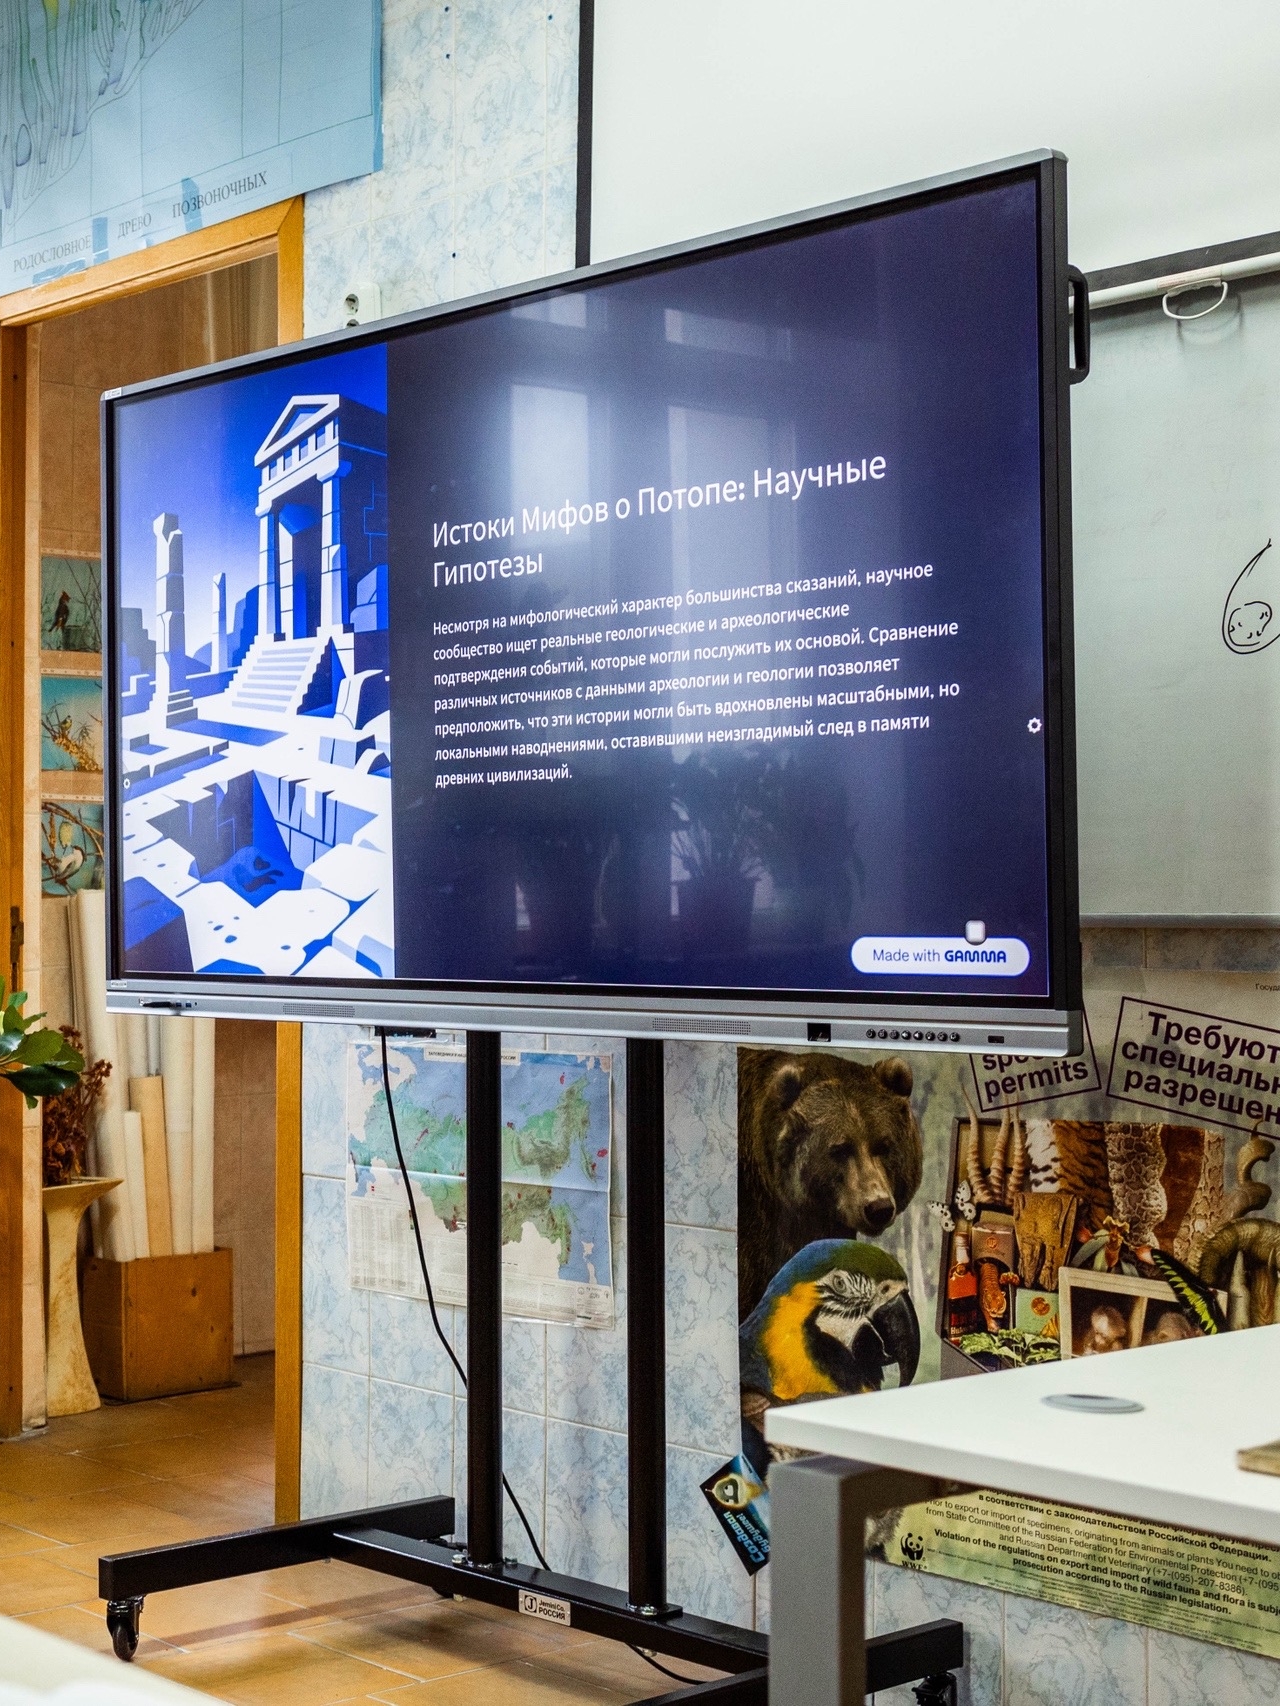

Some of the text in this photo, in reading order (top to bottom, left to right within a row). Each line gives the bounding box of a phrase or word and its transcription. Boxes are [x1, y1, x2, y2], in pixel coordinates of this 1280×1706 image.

[13, 170, 268, 272] РОДОСЛОВНОЕ ДРЕВО ПОЗВОНОЧНЫХ
[433, 455, 886, 548] Истоки Мифов о Потопе: Научные
[433, 553, 543, 588] Гипотезы
[433, 563, 933, 636] Несмотря на мифологический характер большинства сказаний, научное
[433, 602, 850, 661] сообщество ищет реальные геологические и археологические
[433, 621, 959, 687] подтверждения событий, которые могли послужить их основой. Сравнение
[434, 656, 900, 714] различных источников с данными археологии и геологии позволяет
[435, 683, 960, 737] предположить, что эти истории могли быть вдохновлены масштабными, но
[435, 715, 930, 761] локальными наводнениями, оставившими неизгладимый след в памяти
[436, 763, 572, 789] древних цивилизаций.
[873, 949, 1007, 963] Made with GAMMA
[984, 1060, 1089, 1103] permits
[1124, 1069, 1280, 1125] разрешен
[925, 1506, 945, 1518] from
[946, 1511, 967, 1522] State
[968, 1515, 1011, 1532] Committee
[1012, 1523, 1021, 1533] of
[1021, 1527, 1034, 1537] the
[1034, 1530, 1068, 1544] Russian
[1069, 1535, 1113, 1554] Federation
[1114, 1546, 1127, 1557] for
[1128, 1550, 1189, 1572] Environmental
[1190, 1564, 1237, 1582] Protection
[945, 1500, 954, 1509] to
[954, 1503, 980, 1515] export
[981, 1508, 989, 1516] or
[990, 1509, 1016, 1523] import
[1017, 1516, 1026, 1524] of
[1026, 1518, 1073, 1536] specimens,
[1074, 1528, 1118, 1546] originating
[1119, 1537, 1140, 1549] from
[1141, 1544, 1175, 1557] animals
[1176, 1551, 1185, 1559] or
[1187, 1553, 1214, 1566] plants
[1215, 1558, 1234, 1570] You
[1235, 1564, 1258, 1576] need
[1260, 1567, 1270, 1578] to
[985, 1495, 1045, 1515] соответствии
[1054, 1510, 1147, 1536] законодательством
[1148, 1528, 1207, 1549] Российской
[1209, 1541, 1272, 1562] Федерации.
[999, 1533, 1015, 1543] and
[1016, 1537, 1045, 1550] Russian
[1047, 1543, 1096, 1562] Department
[1098, 1554, 1107, 1564] of
[1108, 1557, 1151, 1575] Veterinary
[934, 1528, 971, 1543] Violation
[972, 1537, 982, 1546] of
[983, 1539, 997, 1549] the
[998, 1543, 1045, 1561] regulations
[1046, 1555, 1059, 1564] on
[1060, 1559, 1090, 1573] export
[1091, 1564, 1108, 1575] and
[1110, 1567, 1140, 1583] import
[1141, 1576, 1151, 1585] of
[1153, 1579, 1172, 1590] wild
[1173, 1583, 1201, 1596] fauna
[1203, 1590, 1221, 1601] and
[1222, 1594, 1245, 1607] flora
[1247, 1600, 1256, 1609] is
[1257, 1603, 1280, 1616] subj
[1012, 1557, 1064, 1575] prosecution
[1065, 1570, 1111, 1588] according
[1113, 1580, 1122, 1589] to
[1123, 1582, 1138, 1593] the
[1140, 1586, 1178, 1602] Russian
[1178, 1595, 1232, 1615] legislation.
[539, 1607, 565, 1620] РОССИЯ
